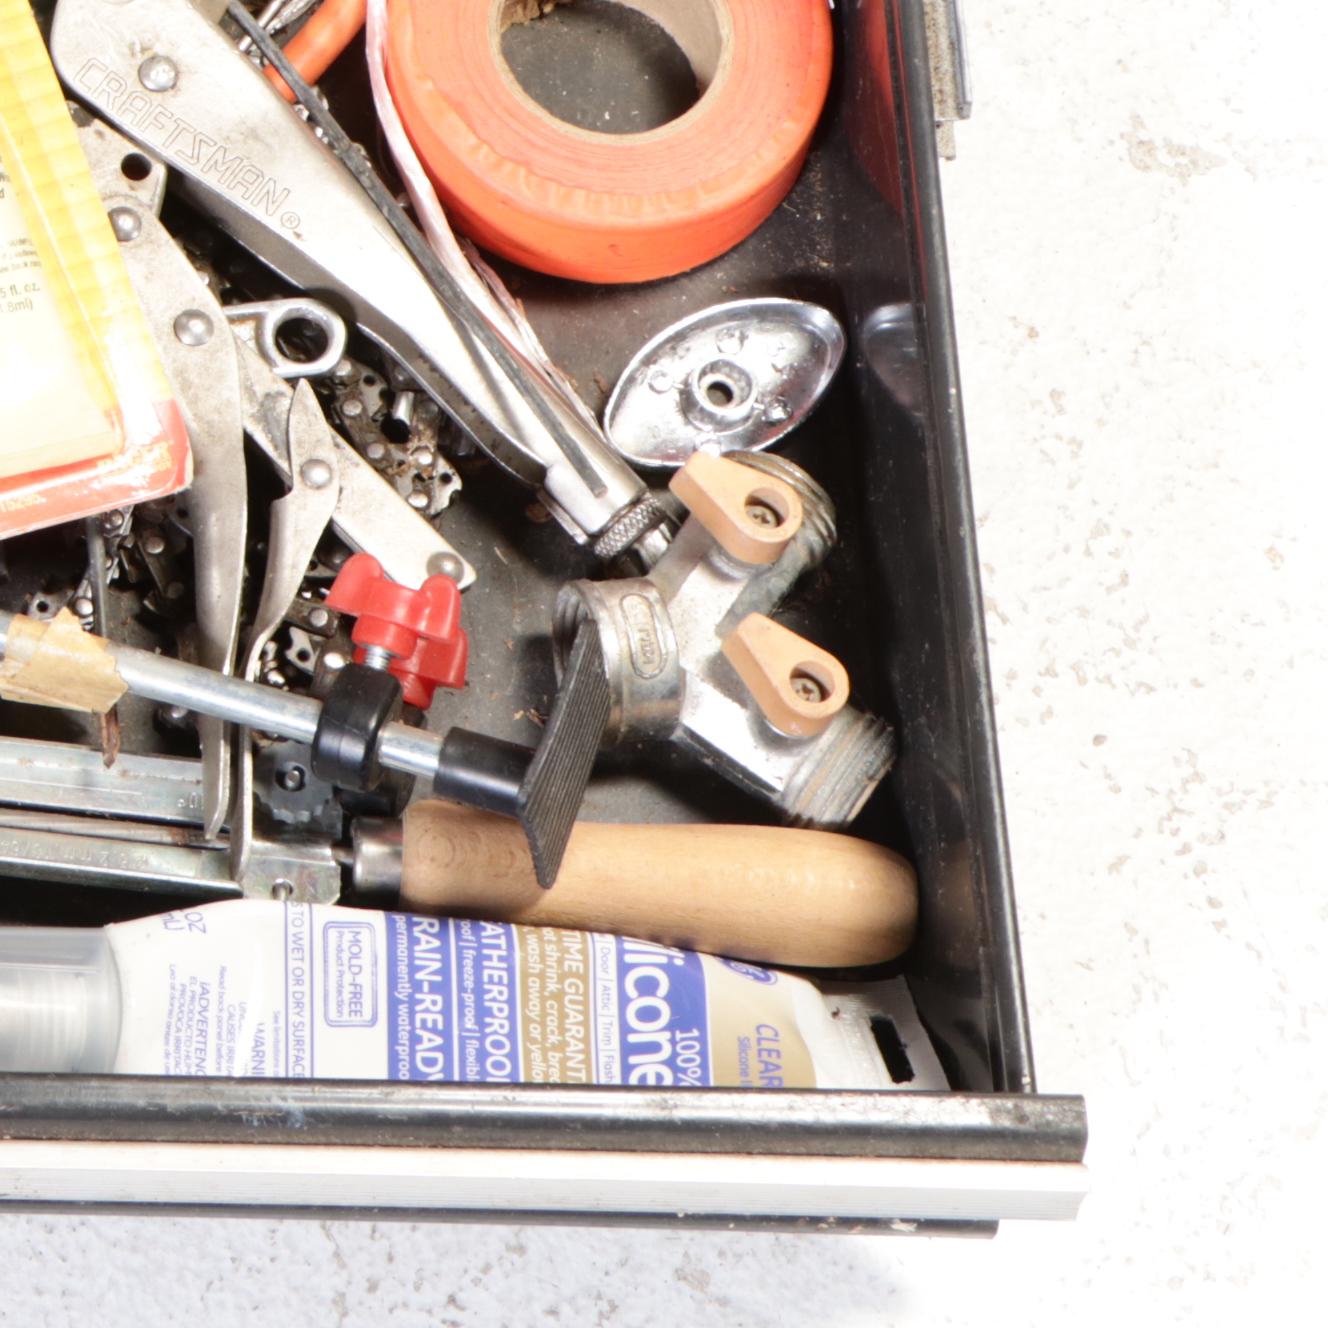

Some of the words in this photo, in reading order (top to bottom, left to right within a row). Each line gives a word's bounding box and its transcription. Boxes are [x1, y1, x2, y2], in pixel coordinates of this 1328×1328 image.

[73, 57, 290, 218] CRAFTSMAN
[291, 909, 305, 928] TO
[291, 932, 305, 963] WET
[336, 930, 345, 966] Product
[392, 914, 413, 1002] permanently
[527, 934, 544, 974] wash
[600, 947, 612, 976] Door
[218, 965, 228, 989] Read
[291, 966, 305, 987] OR
[347, 930, 364, 1019] MOLD-FREE
[461, 949, 478, 1030] freeze-proof
[544, 943, 562, 996] shrink,
[174, 983, 188, 1033] PROVOCA
[217, 991, 226, 1014] back
[292, 990, 305, 1019] DRY
[336, 968, 345, 1018] Protection
[479, 920, 512, 1083] ATHERPROO
[525, 977, 542, 1021] away
[600, 984, 612, 1013] Attic
[183, 990, 197, 1047] PRODUCTO
[215, 1015, 225, 1042] panel
[530, 1024, 543, 1041] or
[546, 1000, 563, 1047] crack,
[563, 978, 587, 1084] GUARANT
[600, 1022, 613, 1047] Trim
[215, 1043, 225, 1073] before
[465, 1039, 481, 1081] flexibl
[527, 1042, 547, 1083] yello
[675, 1028, 702, 1086] 100%
[737, 1035, 753, 1075] Silicone
[756, 1024, 784, 1087] CLEAR
